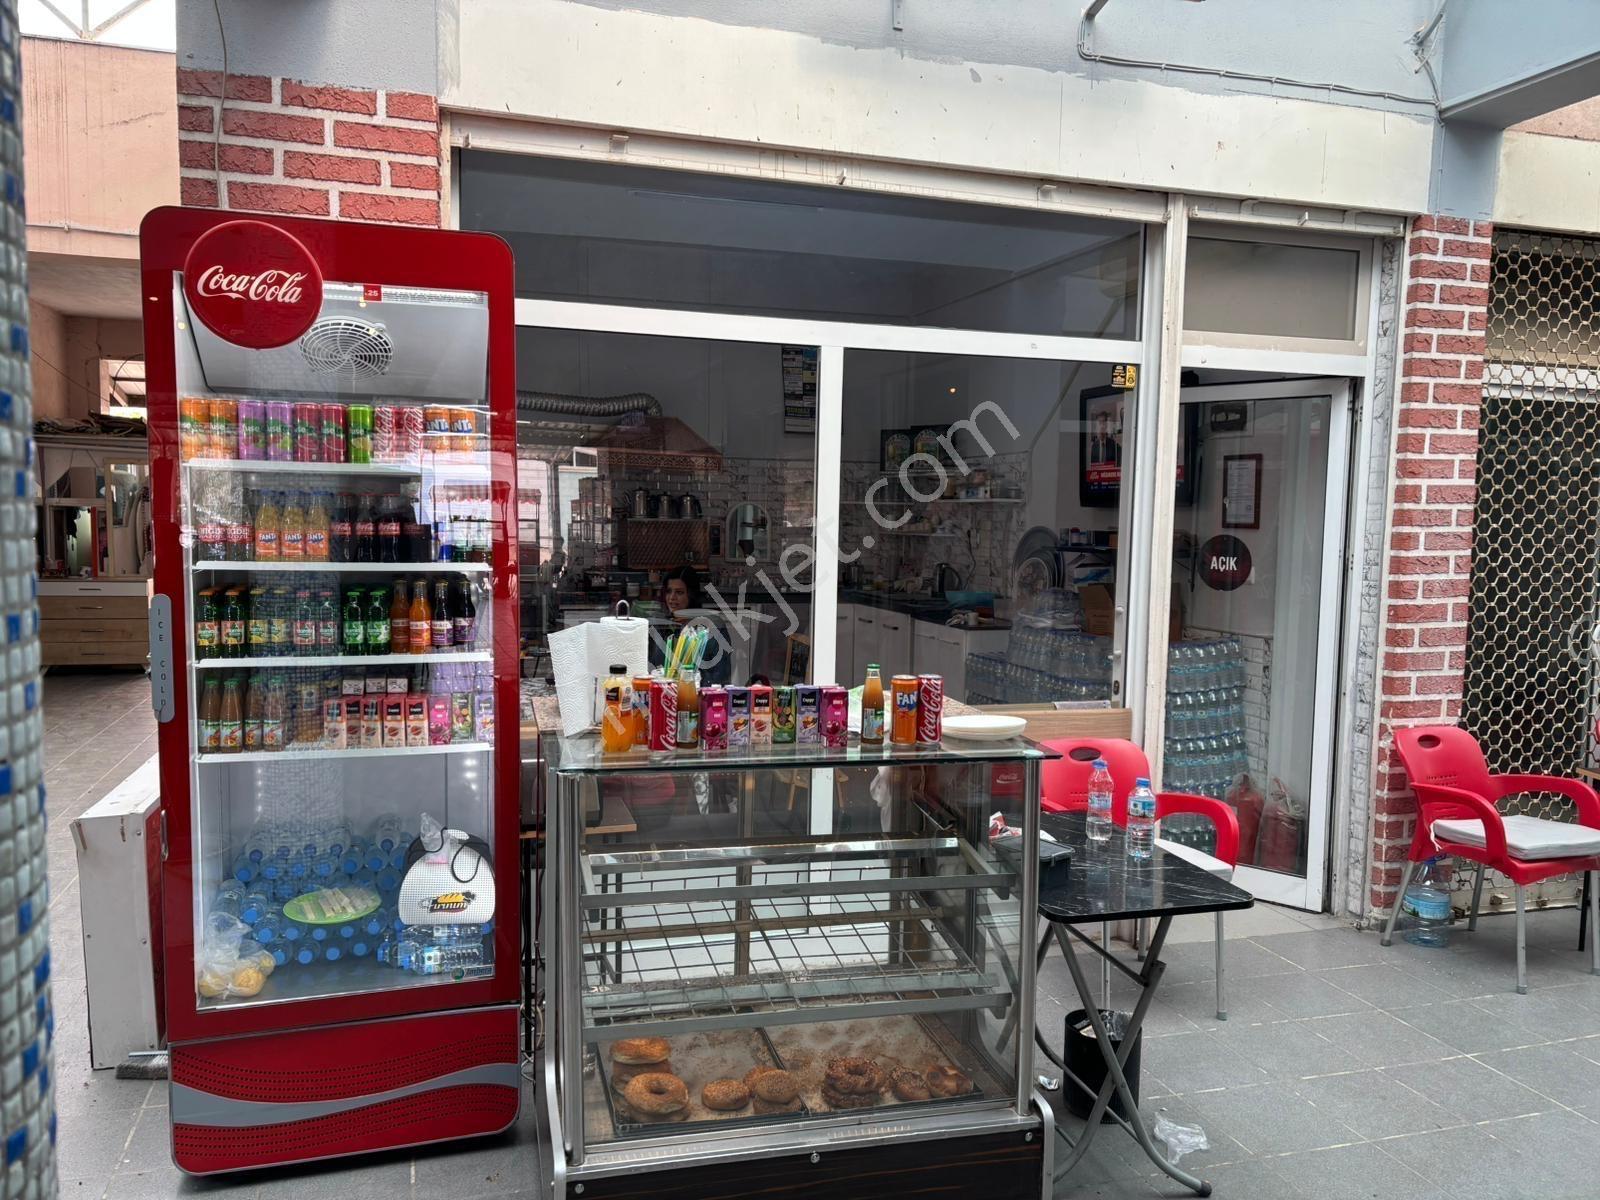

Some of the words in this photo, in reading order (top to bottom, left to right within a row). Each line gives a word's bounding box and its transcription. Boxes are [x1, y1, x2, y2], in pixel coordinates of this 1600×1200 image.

[197, 265, 309, 305] Coca-Cola
[1210, 556, 1238, 572] AÇIK
[919, 677, 943, 744] Coca-Cola
